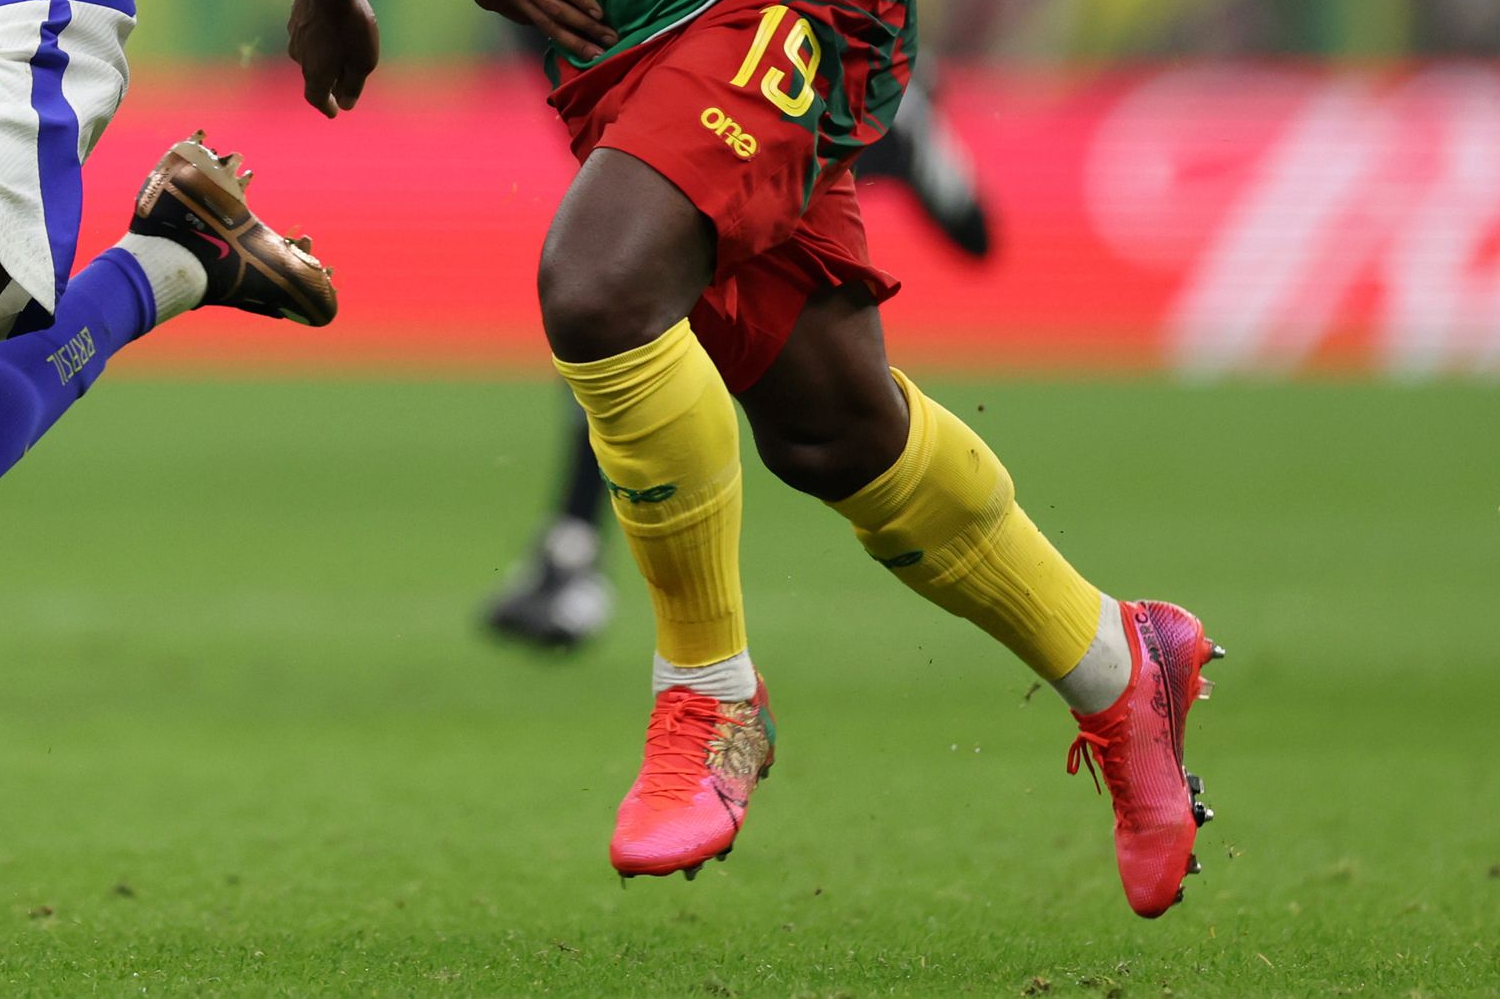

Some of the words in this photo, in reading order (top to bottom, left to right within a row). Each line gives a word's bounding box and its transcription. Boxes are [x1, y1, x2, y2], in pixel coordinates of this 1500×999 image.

[729, 4, 822, 118] 19
[700, 107, 758, 158] one
[46, 326, 96, 386] BRASIL
